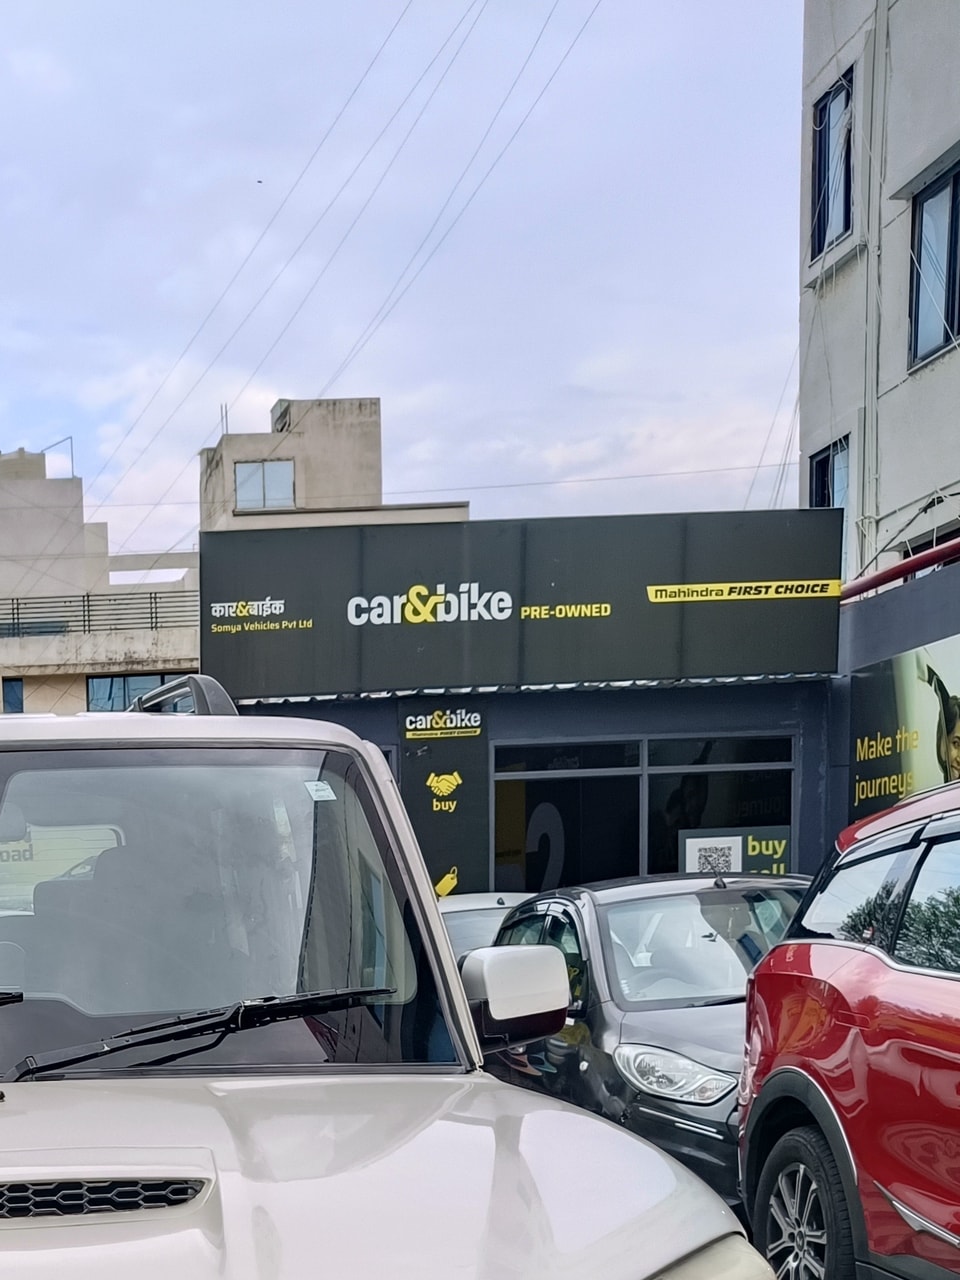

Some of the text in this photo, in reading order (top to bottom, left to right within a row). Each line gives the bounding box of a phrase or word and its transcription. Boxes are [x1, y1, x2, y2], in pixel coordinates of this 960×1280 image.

[655, 583, 830, 600] Mahindra FIRST CHOICE
[347, 582, 611, 626] car&bike PRE-OWNED
[211, 619, 313, 634] Somya Vehicles Pvt Ltd
[405, 709, 481, 730] car&bike
[856, 725, 919, 762] Make the
[854, 771, 913, 807] journeys
[432, 798, 457, 813] buy
[747, 835, 787, 859] buy
